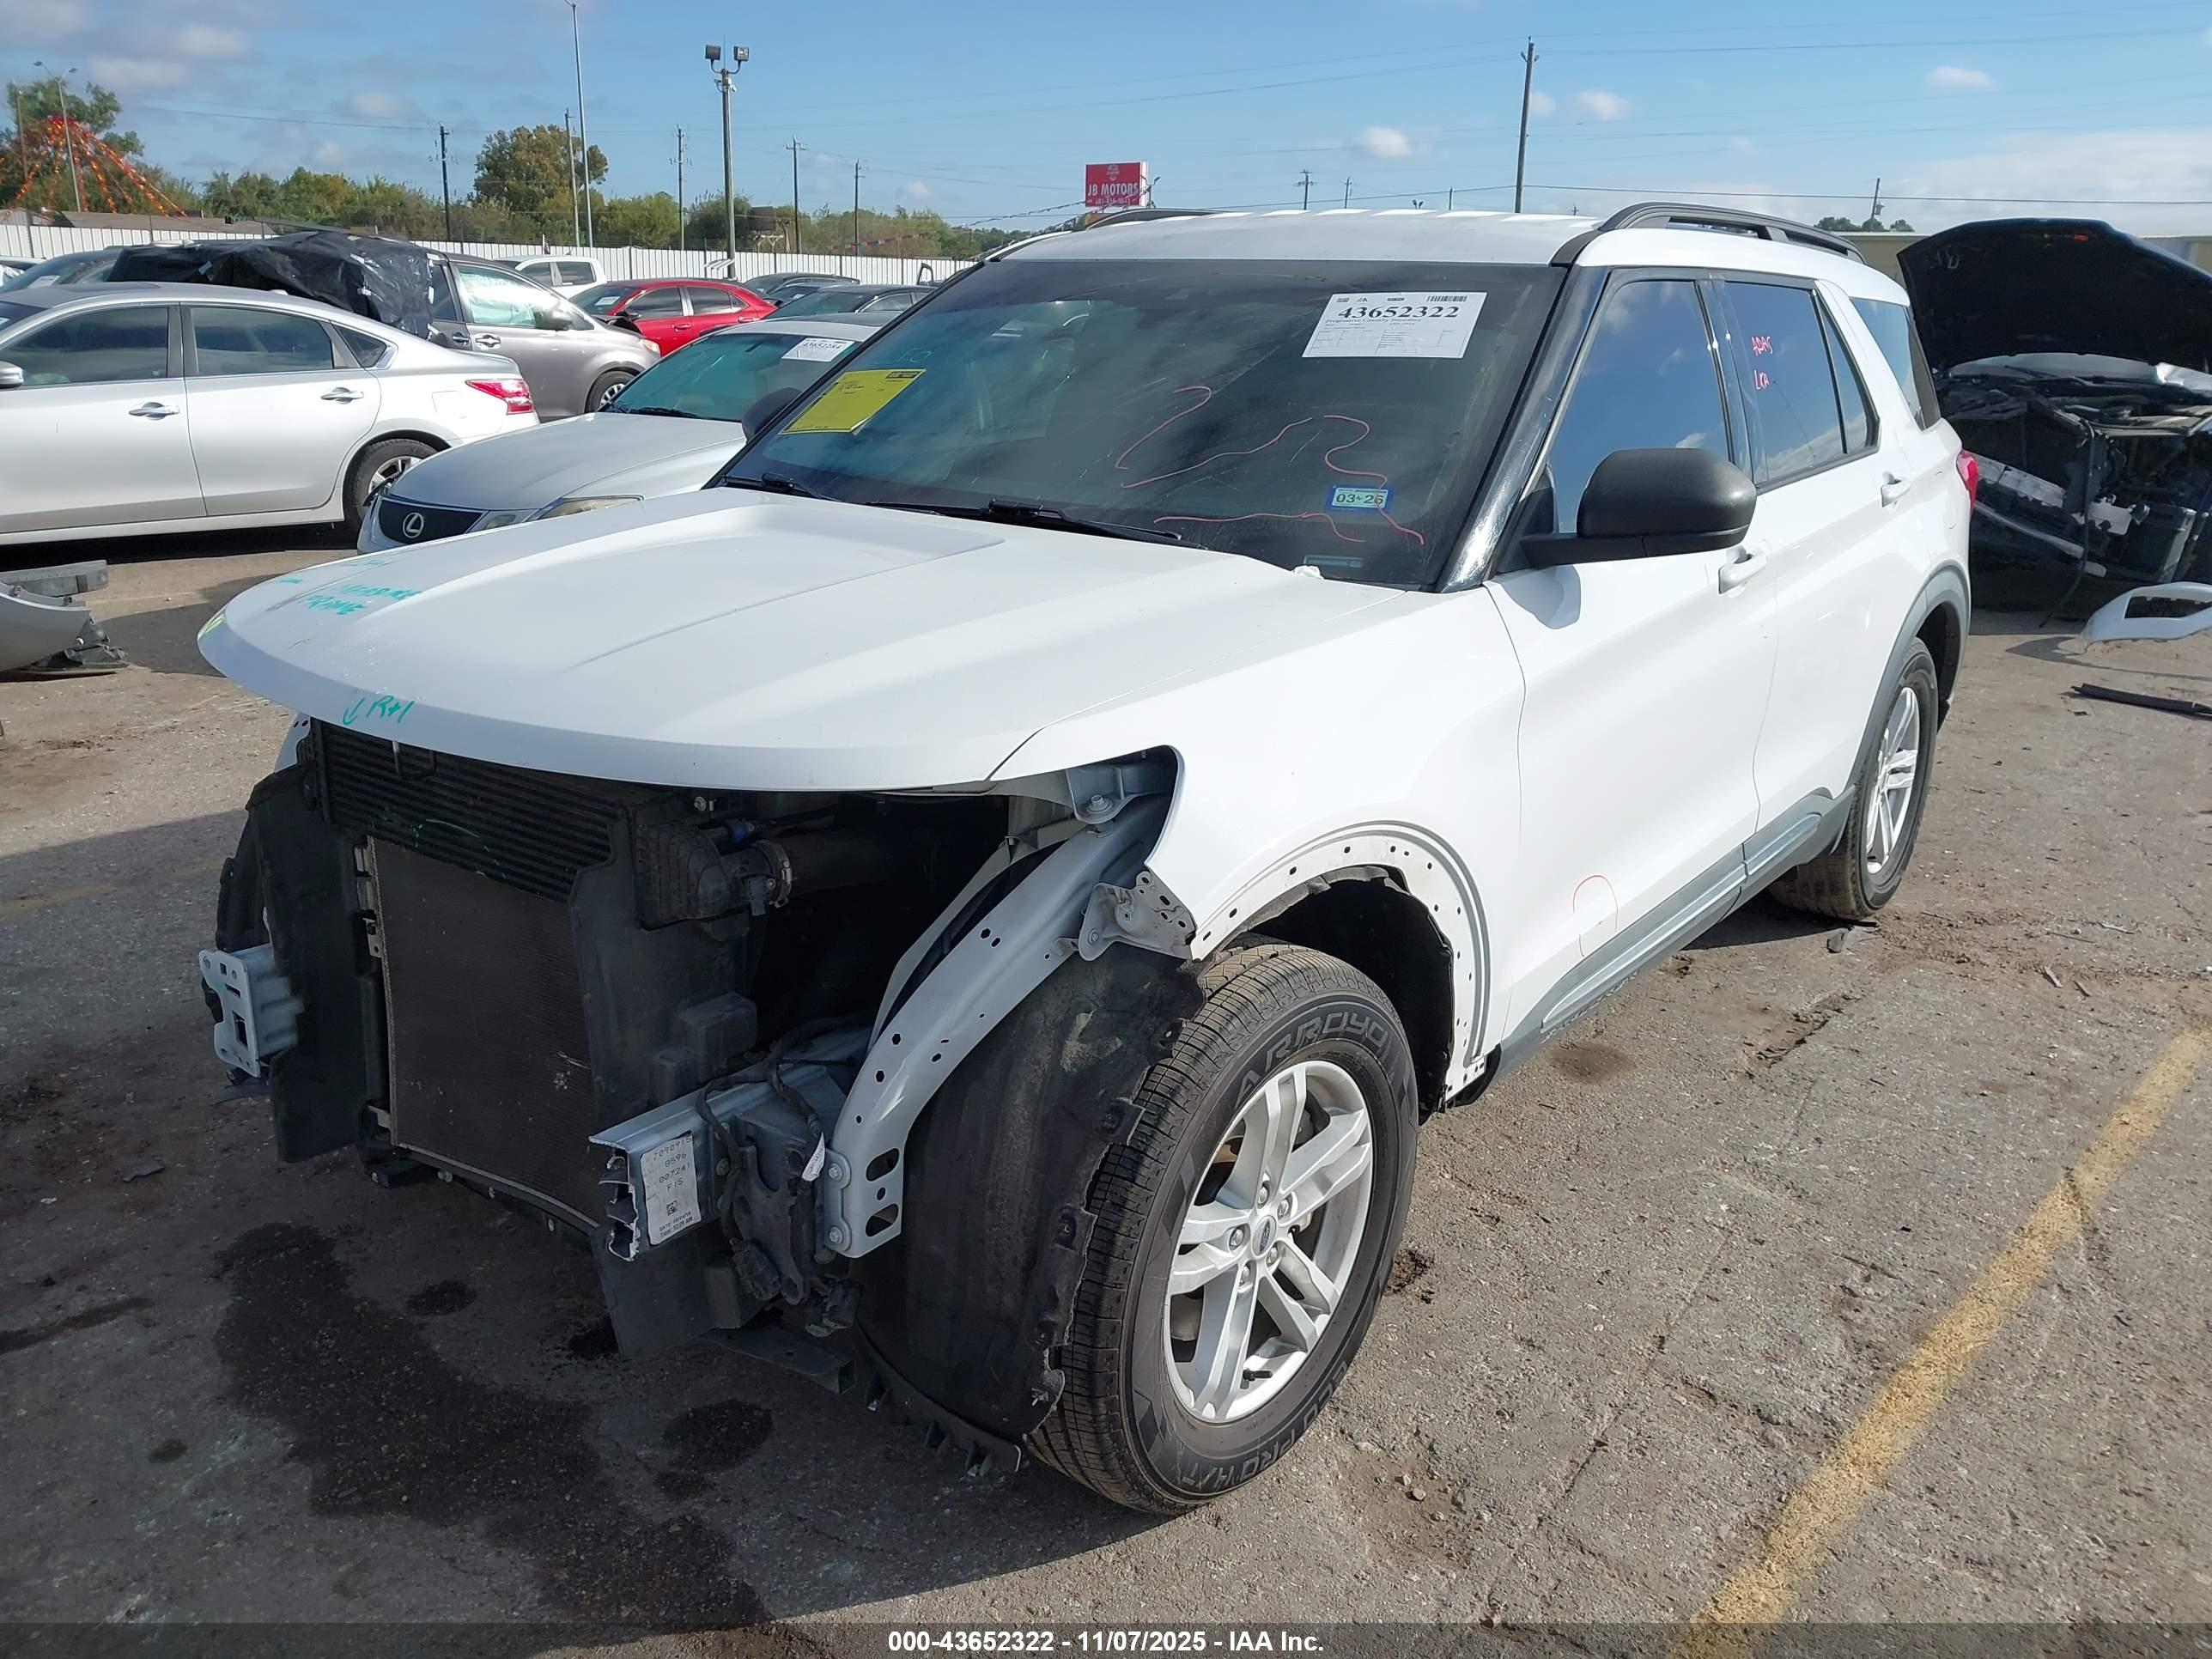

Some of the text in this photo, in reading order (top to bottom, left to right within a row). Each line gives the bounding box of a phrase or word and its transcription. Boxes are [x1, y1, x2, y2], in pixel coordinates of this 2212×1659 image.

[1087, 183, 1139, 196] JB MOTORS
[1338, 306, 1460, 319] 43652322
[1234, 1012, 1389, 1110] ARROYO
